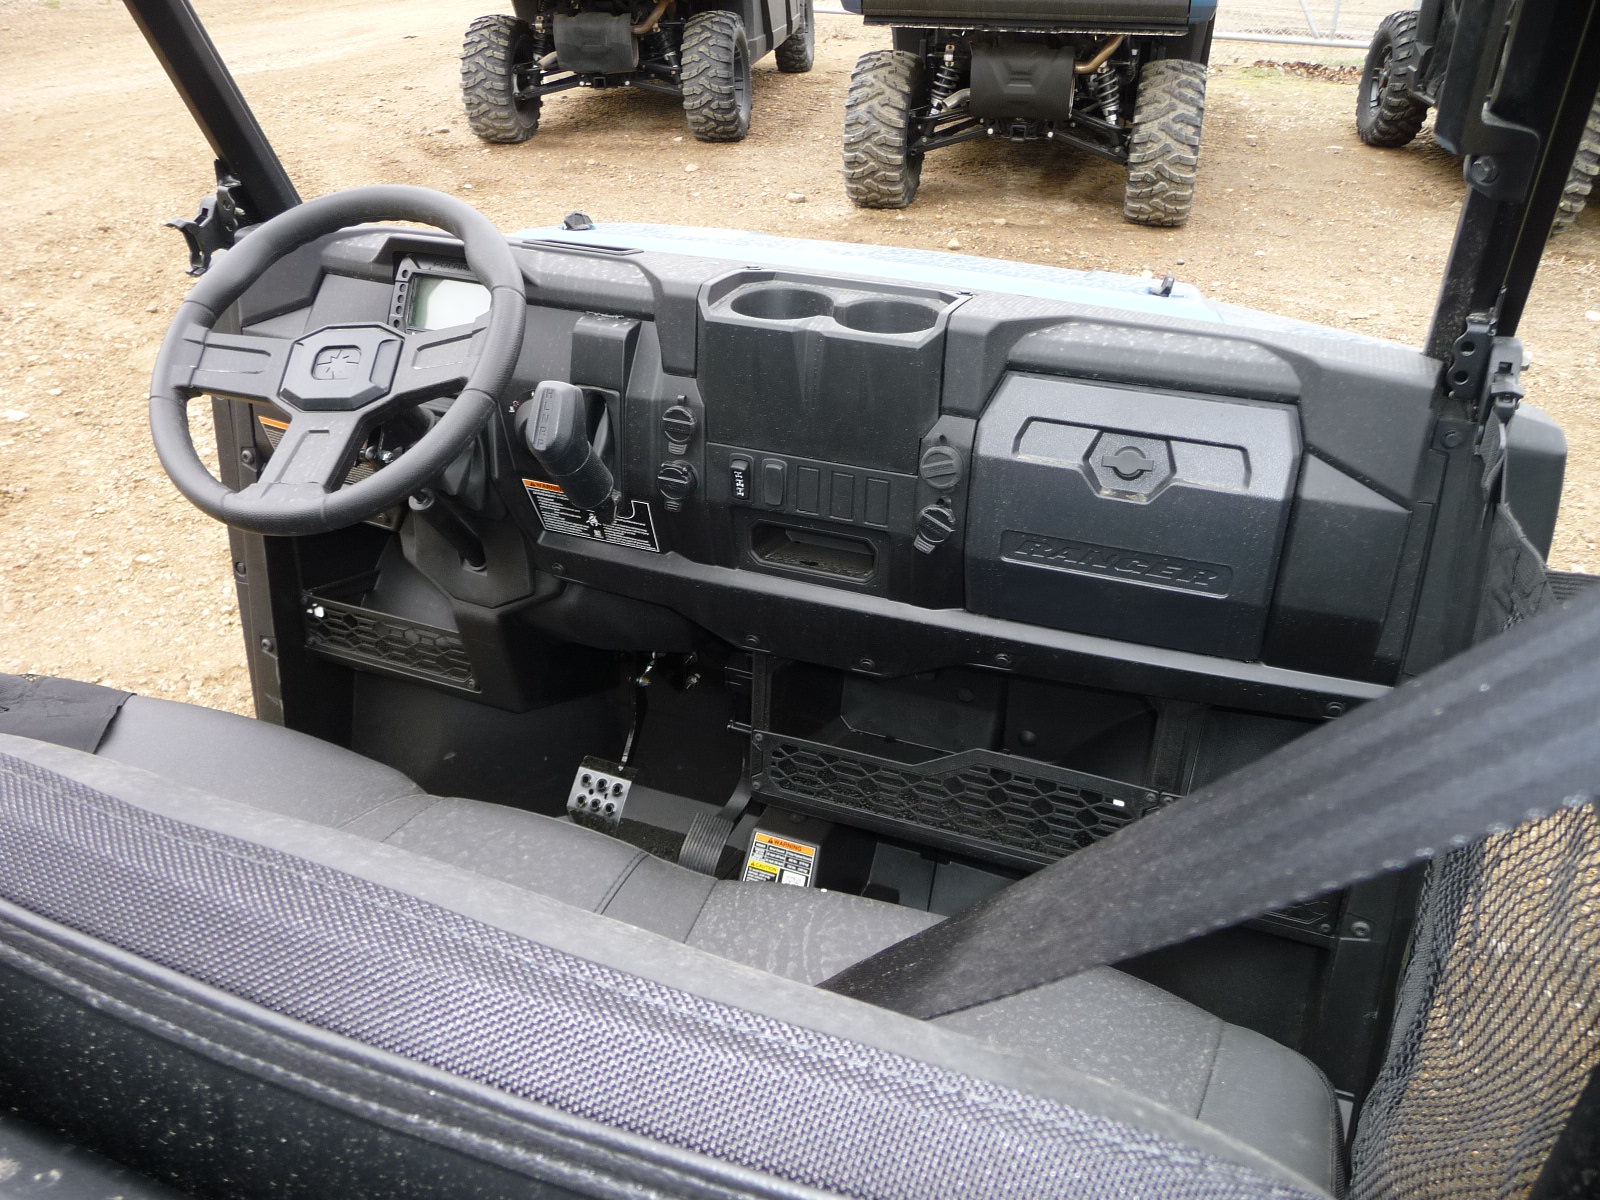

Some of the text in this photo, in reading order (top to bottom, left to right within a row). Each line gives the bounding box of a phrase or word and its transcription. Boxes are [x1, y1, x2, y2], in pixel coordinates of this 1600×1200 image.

[1014, 540, 1219, 586] RANGER
[774, 840, 802, 852] WARNING
[755, 862, 777, 872] CAUTION
